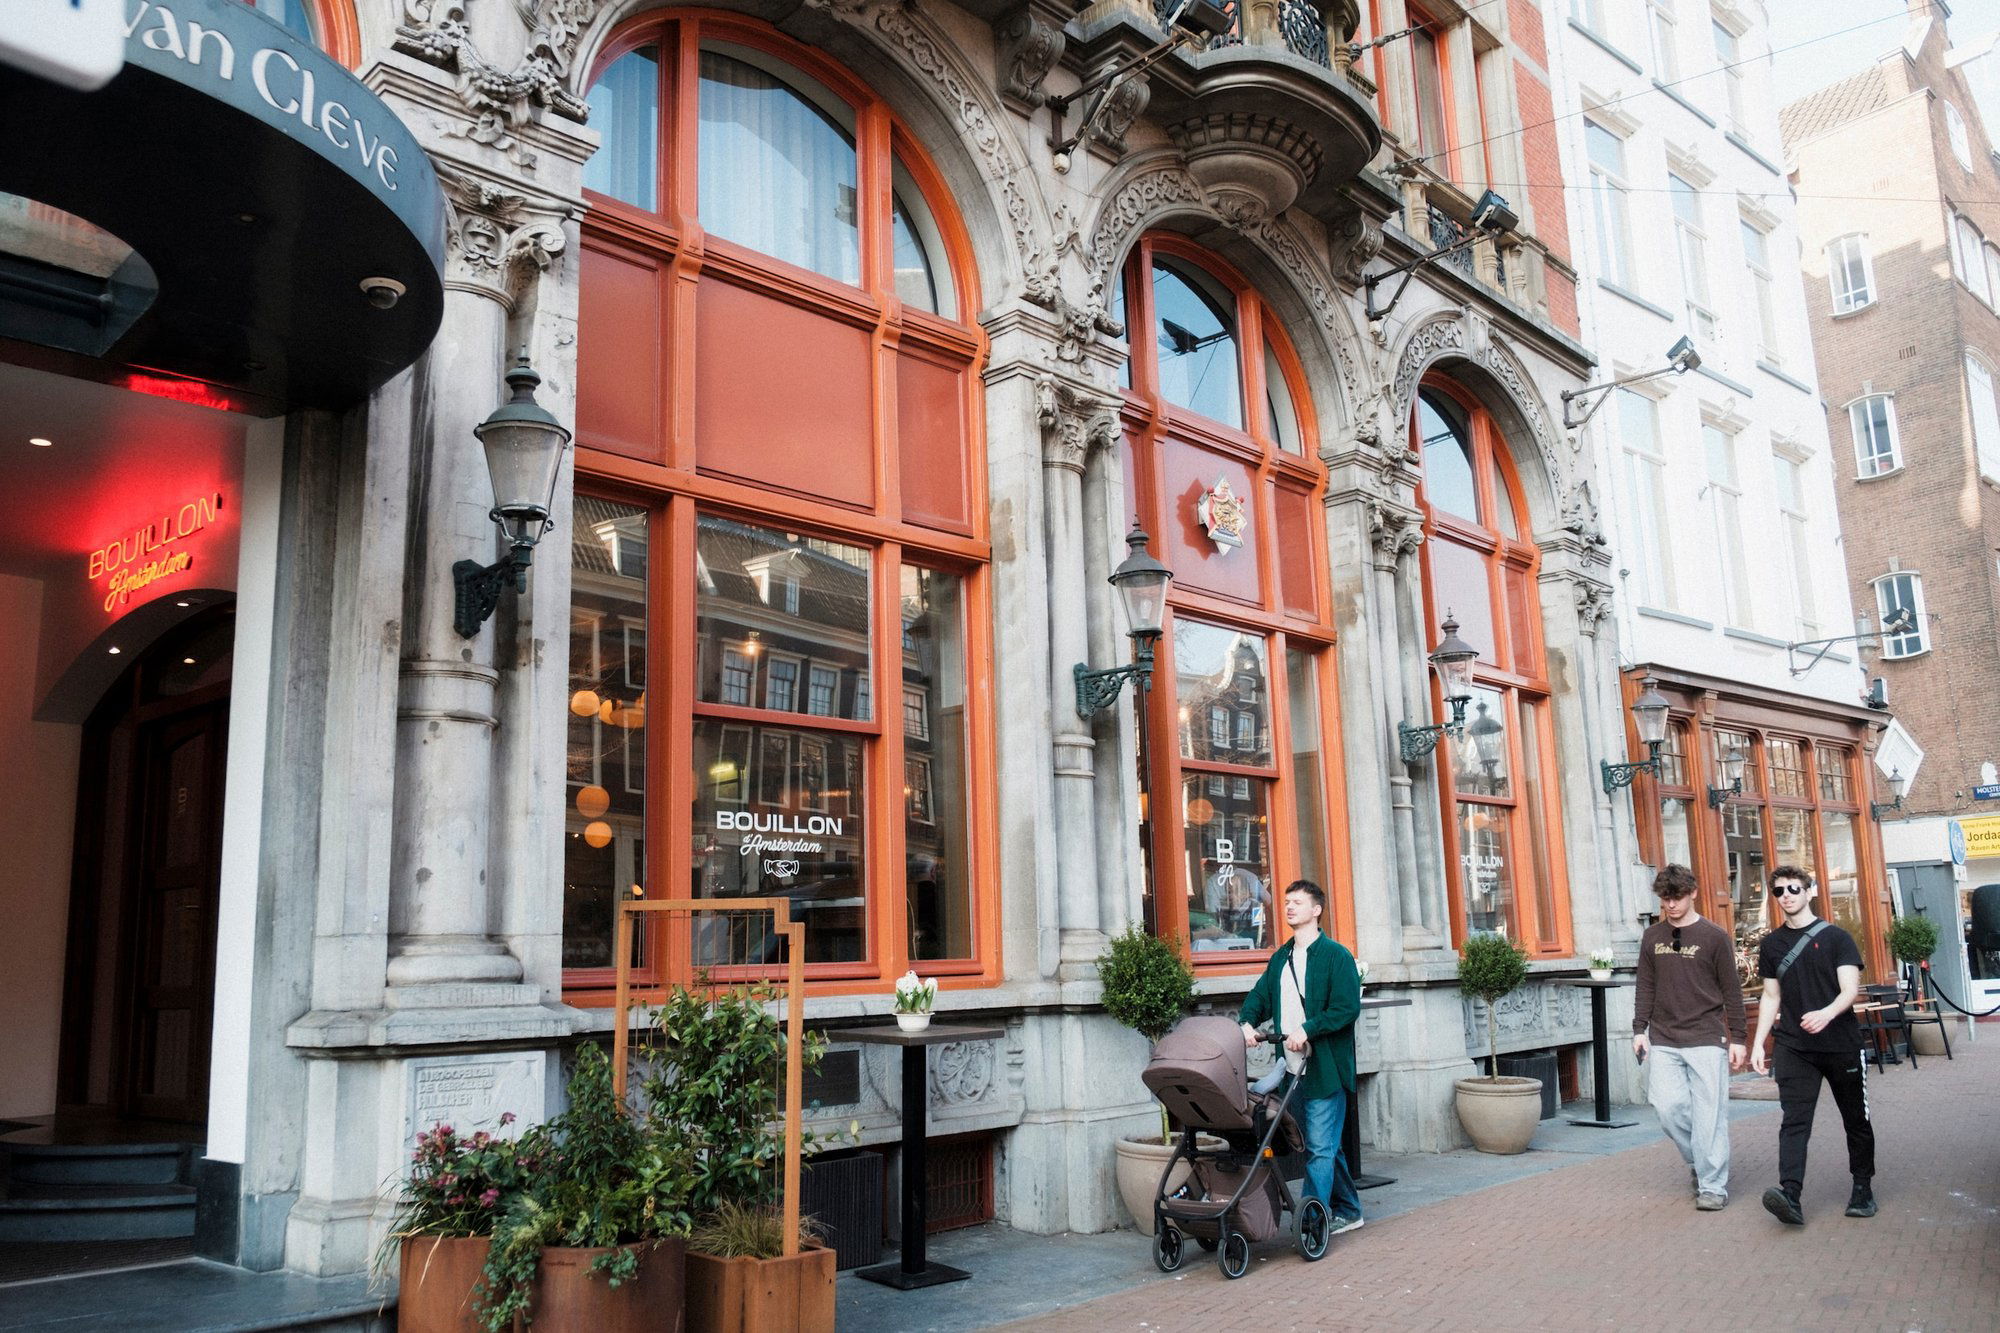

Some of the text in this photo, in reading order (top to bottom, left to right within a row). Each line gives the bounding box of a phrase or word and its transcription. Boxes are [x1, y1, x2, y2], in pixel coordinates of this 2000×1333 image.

[89, 492, 219, 579] BOUILLON
[716, 810, 843, 836] BOUILLON
[740, 833, 822, 856] d'Amsterdam
[1216, 838, 1235, 863] B
